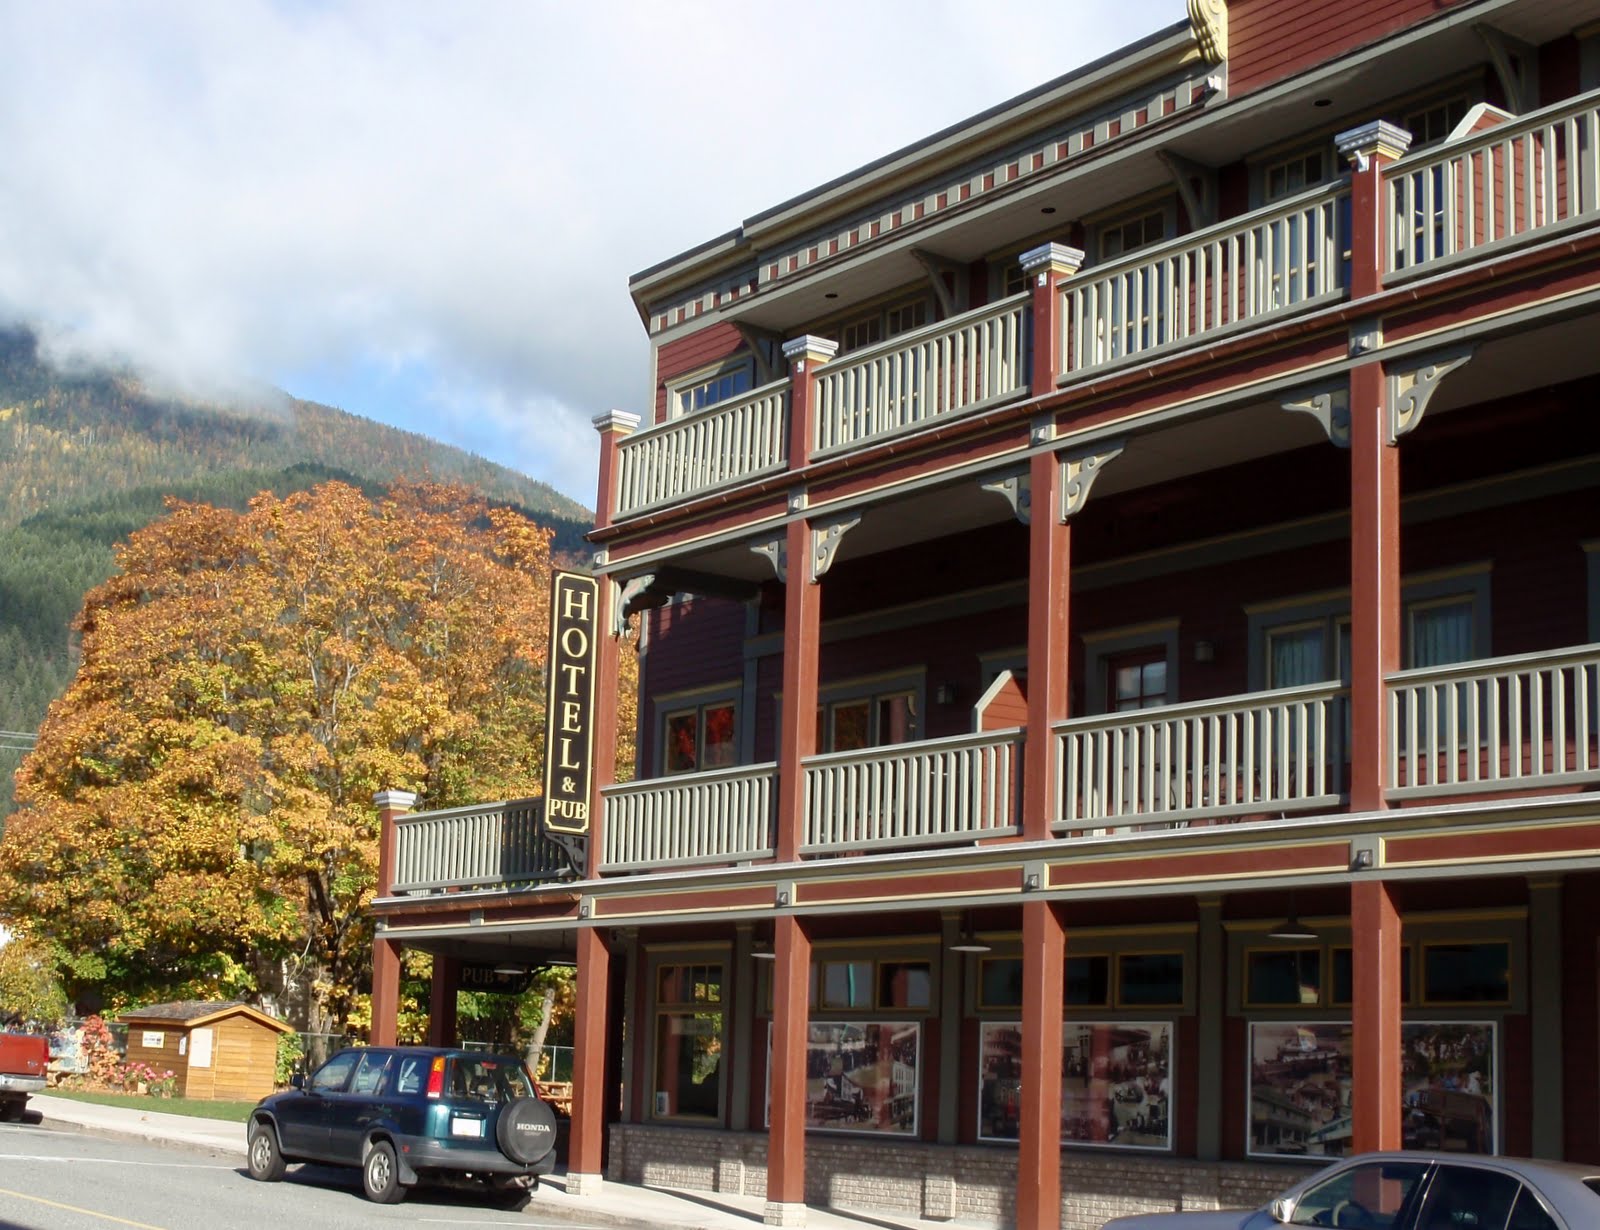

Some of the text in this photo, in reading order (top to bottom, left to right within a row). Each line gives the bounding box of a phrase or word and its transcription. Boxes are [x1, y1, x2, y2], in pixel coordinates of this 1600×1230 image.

[559, 588, 590, 770] HOTEL
[562, 776, 576, 793] &
[550, 799, 586, 819] PUB
[462, 967, 494, 984] PUB
[516, 1123, 550, 1132] HONDA
